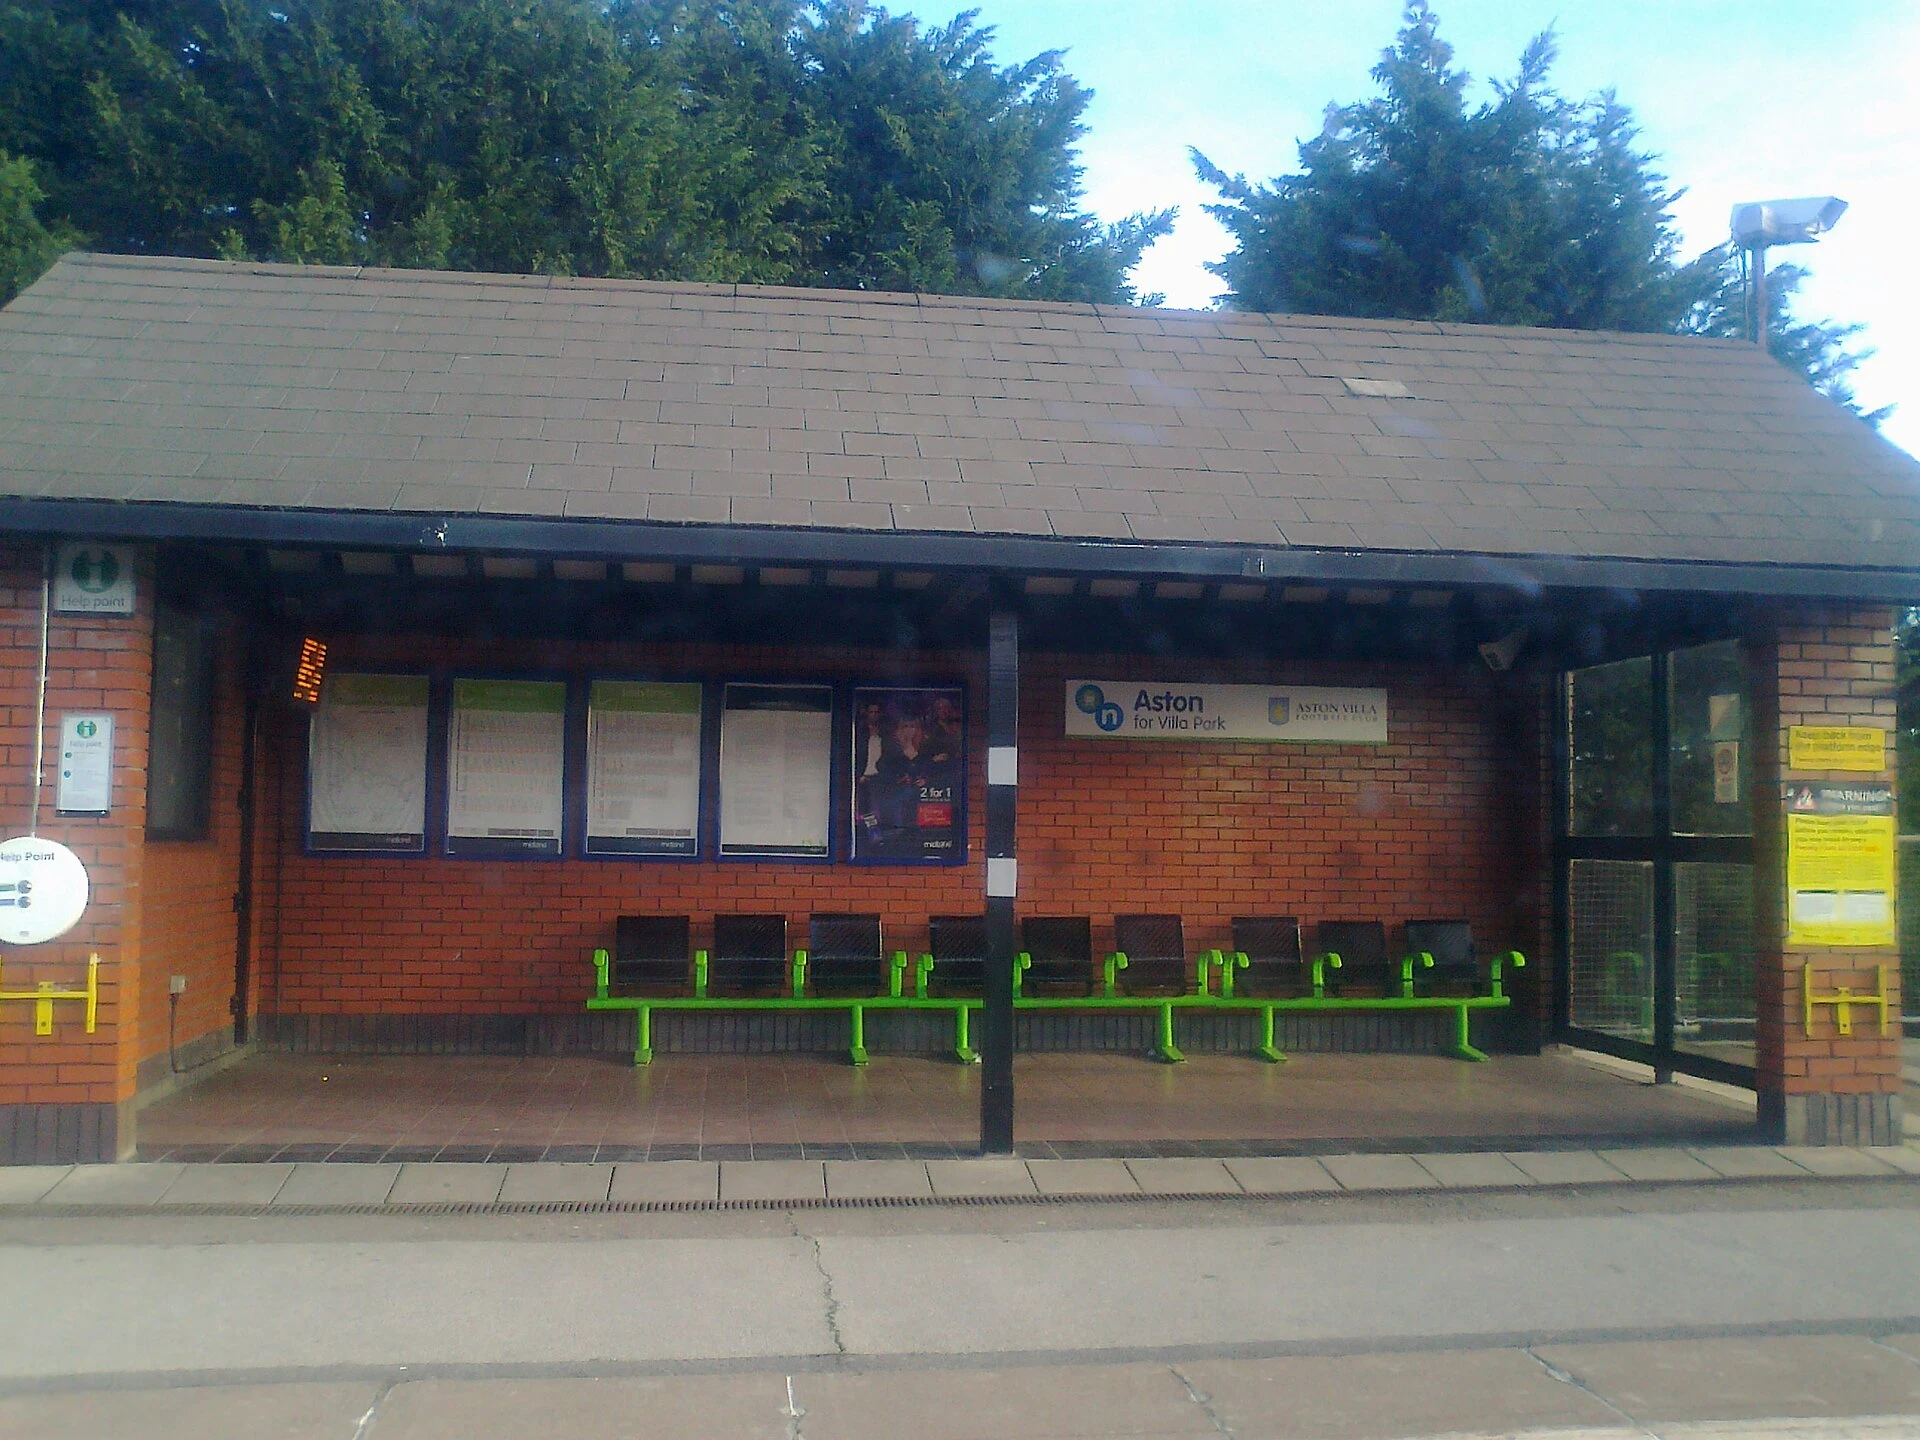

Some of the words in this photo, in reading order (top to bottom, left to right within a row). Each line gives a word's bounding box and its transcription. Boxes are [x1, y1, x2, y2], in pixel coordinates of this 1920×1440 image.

[62, 595, 90, 609] Help
[93, 598, 125, 609] point
[1134, 689, 1203, 713] Aston
[1296, 703, 1338, 713] ASTON
[1342, 704, 1377, 714] VILLA
[1134, 715, 1153, 730] for
[1158, 716, 1188, 730] Villa
[1193, 715, 1226, 730] Park
[920, 787, 928, 798] 2
[930, 788, 943, 798] for
[945, 788, 951, 798] 1
[25, 852, 55, 861] Point
